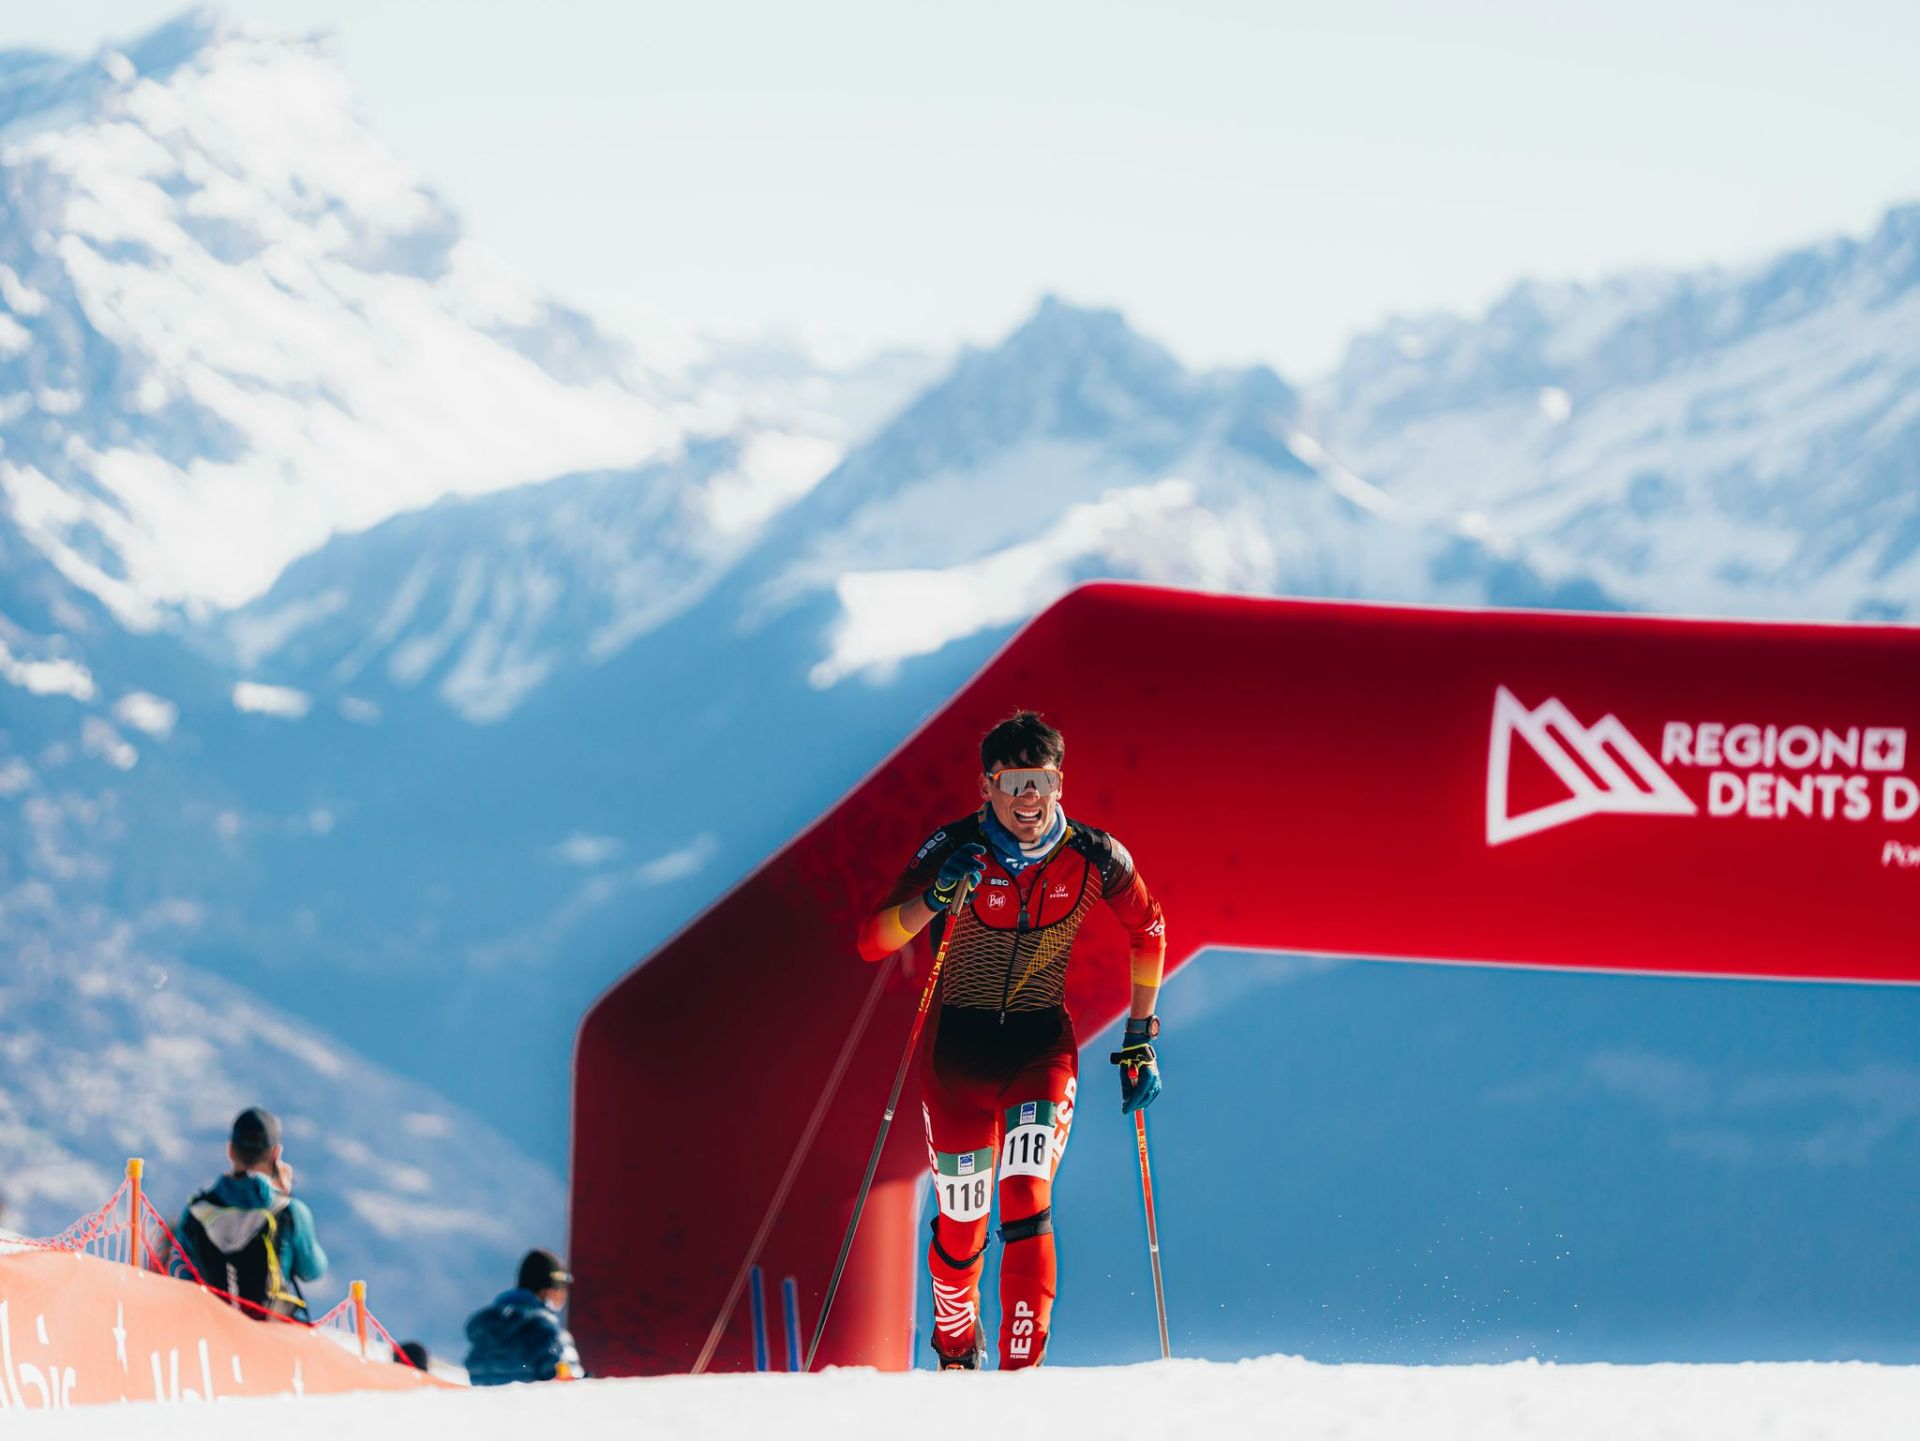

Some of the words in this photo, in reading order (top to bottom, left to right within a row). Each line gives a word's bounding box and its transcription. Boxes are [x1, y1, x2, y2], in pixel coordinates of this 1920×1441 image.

[1662, 721, 1860, 769] REGION
[1709, 771, 1871, 821] DENTS
[932, 941, 949, 976] LEKI
[1009, 1132, 1046, 1165] 118
[946, 1179, 985, 1211] 118
[1010, 1300, 1034, 1354] ESP
